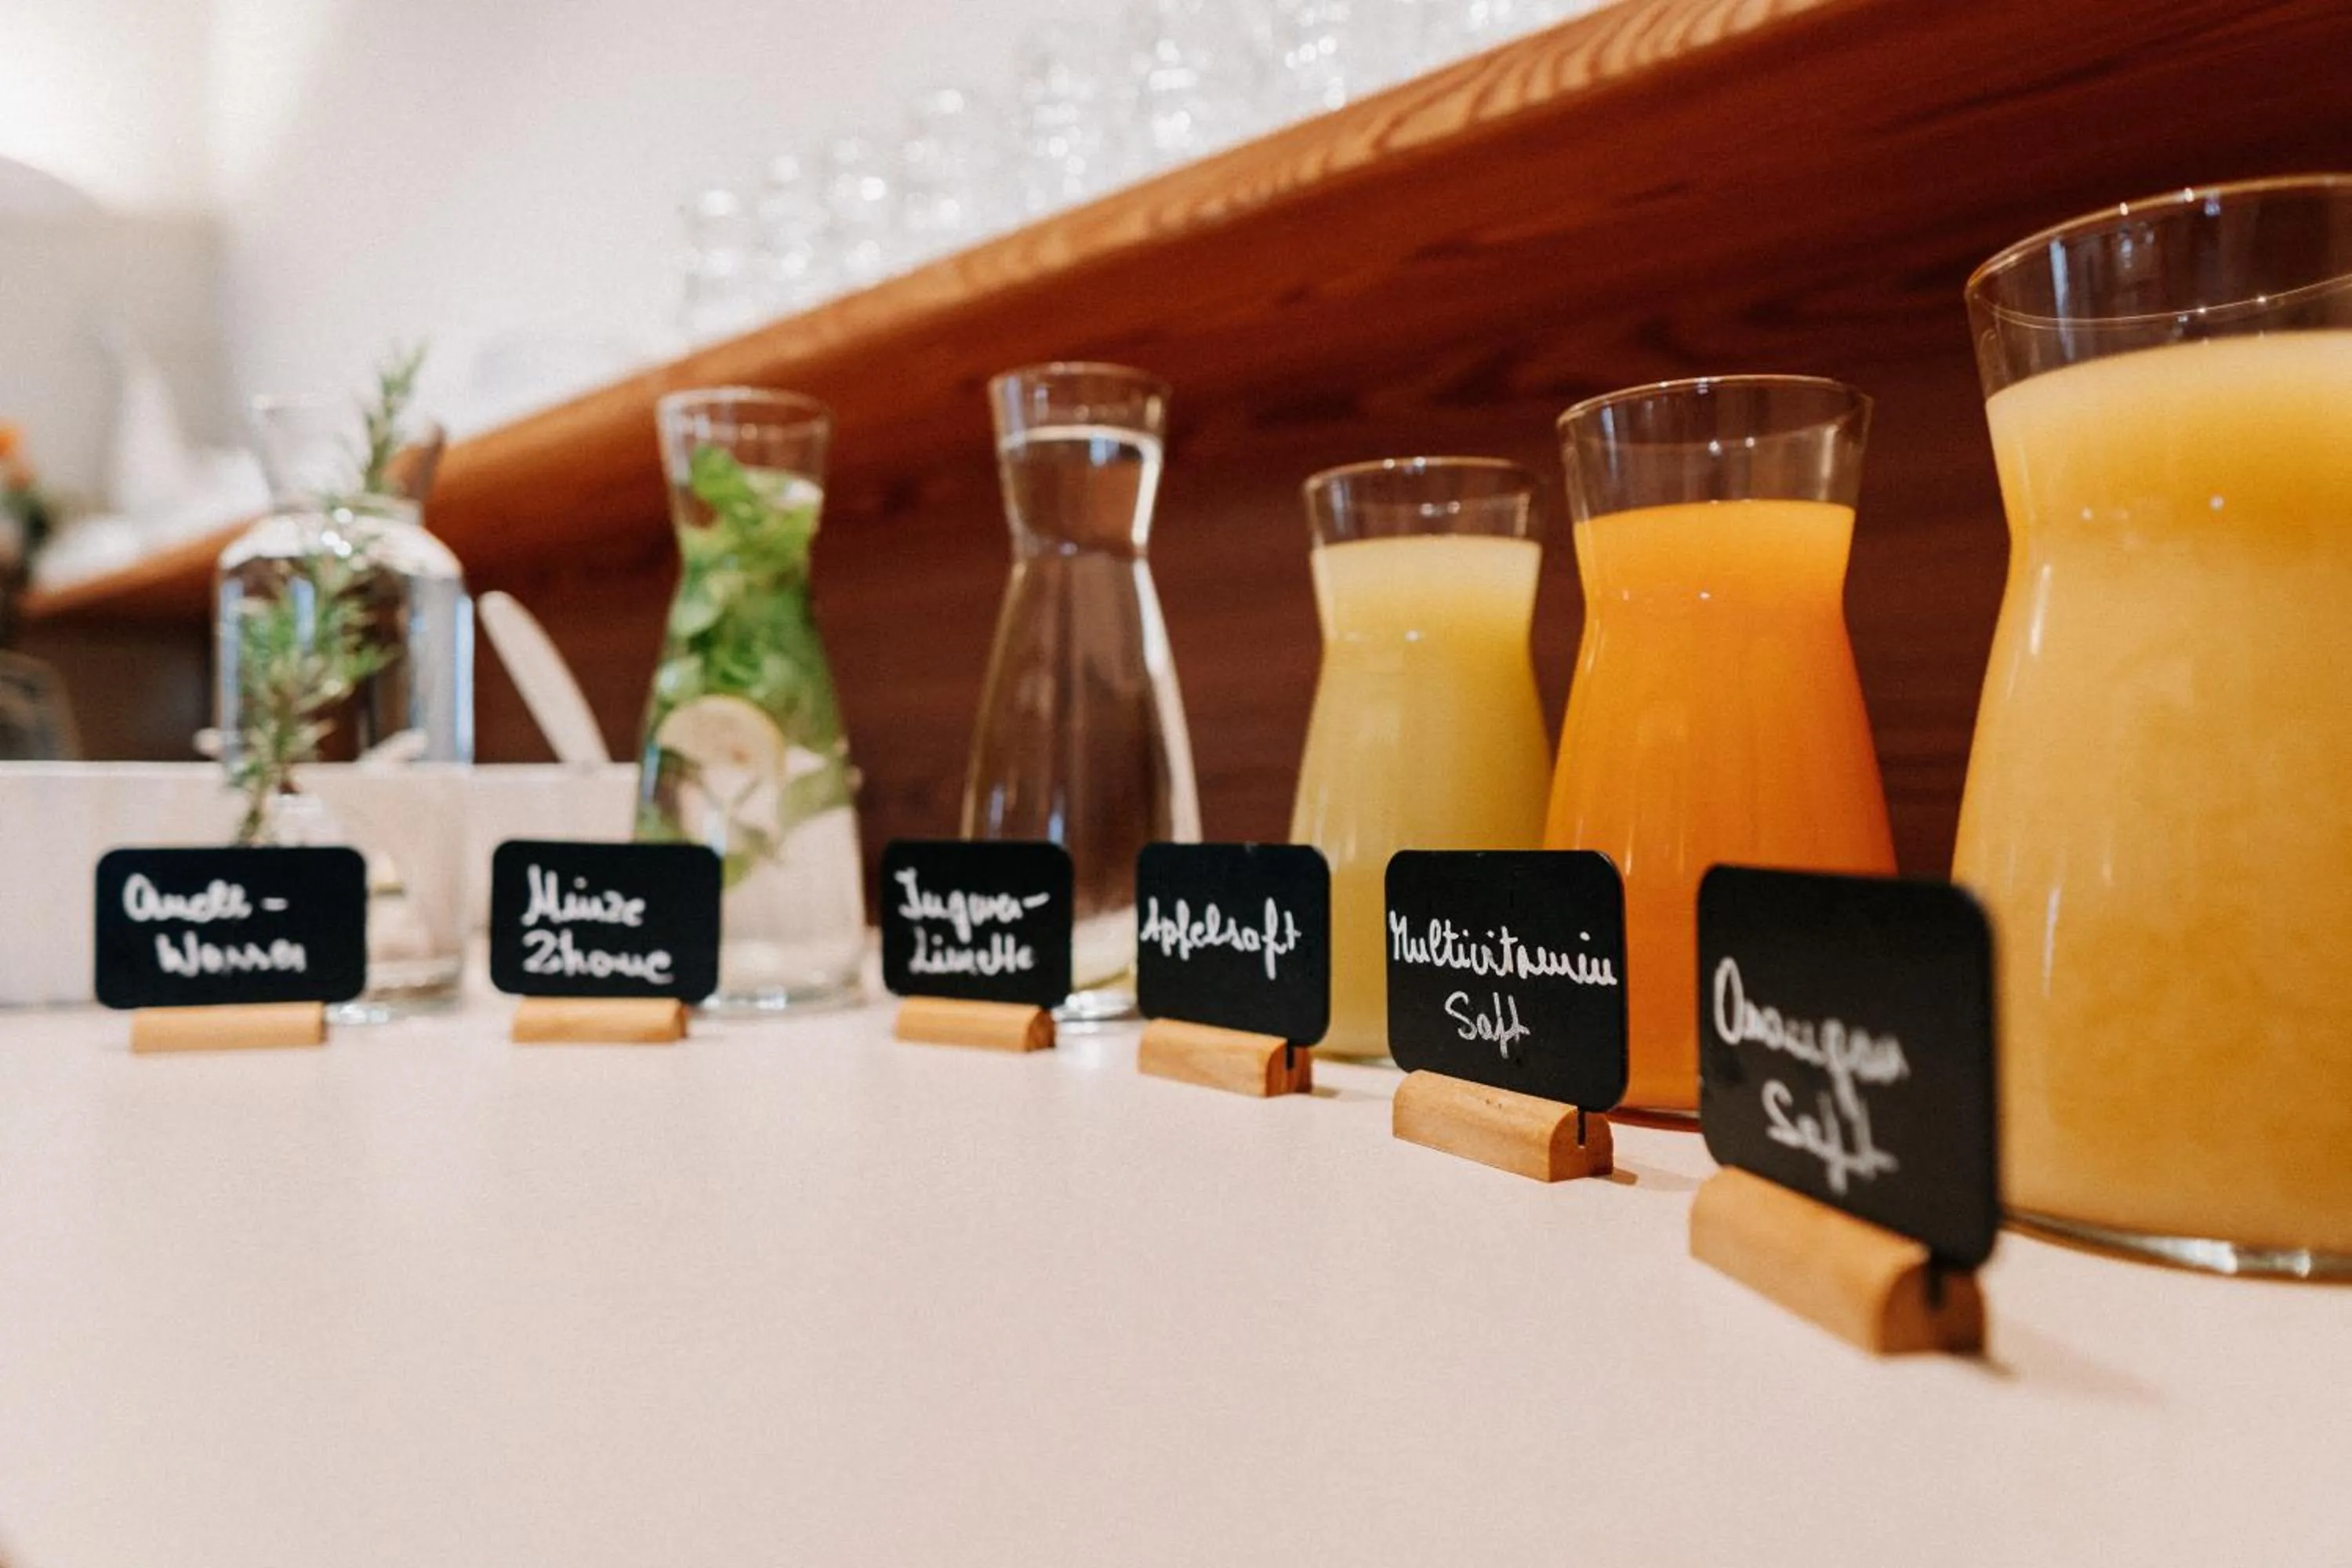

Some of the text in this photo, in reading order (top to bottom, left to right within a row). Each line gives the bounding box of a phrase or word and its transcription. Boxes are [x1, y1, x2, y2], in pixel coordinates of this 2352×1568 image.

[521, 865, 645, 927] Minze
[1140, 897, 1301, 980] Apfelsaft
[1389, 910, 1617, 985] Multivitamin
[1445, 991, 1530, 1058] Saft
[1761, 1078, 1899, 1194] Saft
